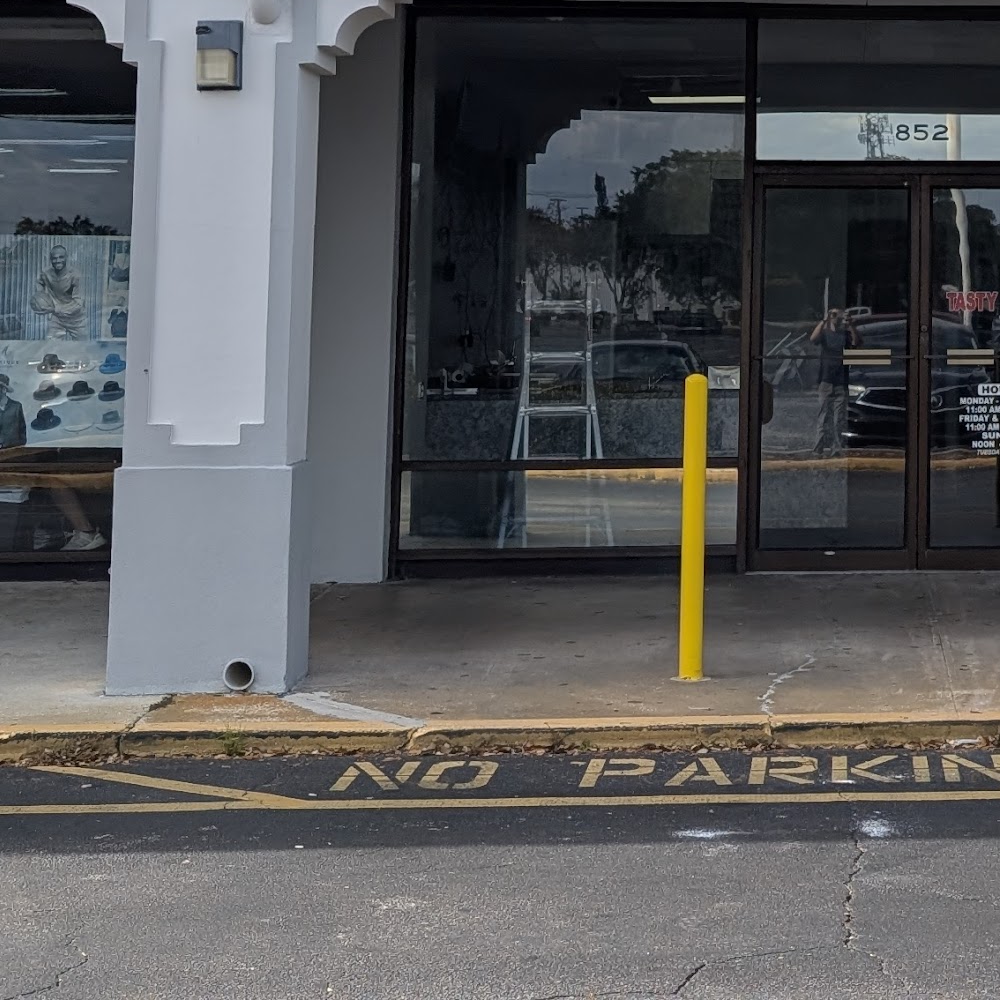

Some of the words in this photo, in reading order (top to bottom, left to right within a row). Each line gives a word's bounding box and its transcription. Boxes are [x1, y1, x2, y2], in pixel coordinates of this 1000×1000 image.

[895, 124, 949, 141] 852
[946, 291, 998, 312] TASTY
[959, 397, 995, 405] MONDAY
[965, 405, 987, 413] 11:00
[989, 405, 1000, 413] AM
[959, 414, 990, 422] FRIDAY
[992, 414, 999, 422] &
[965, 423, 986, 431] 11:00
[987, 423, 1000, 431] AM
[972, 440, 995, 448] NOON
[329, 759, 500, 792] NO
